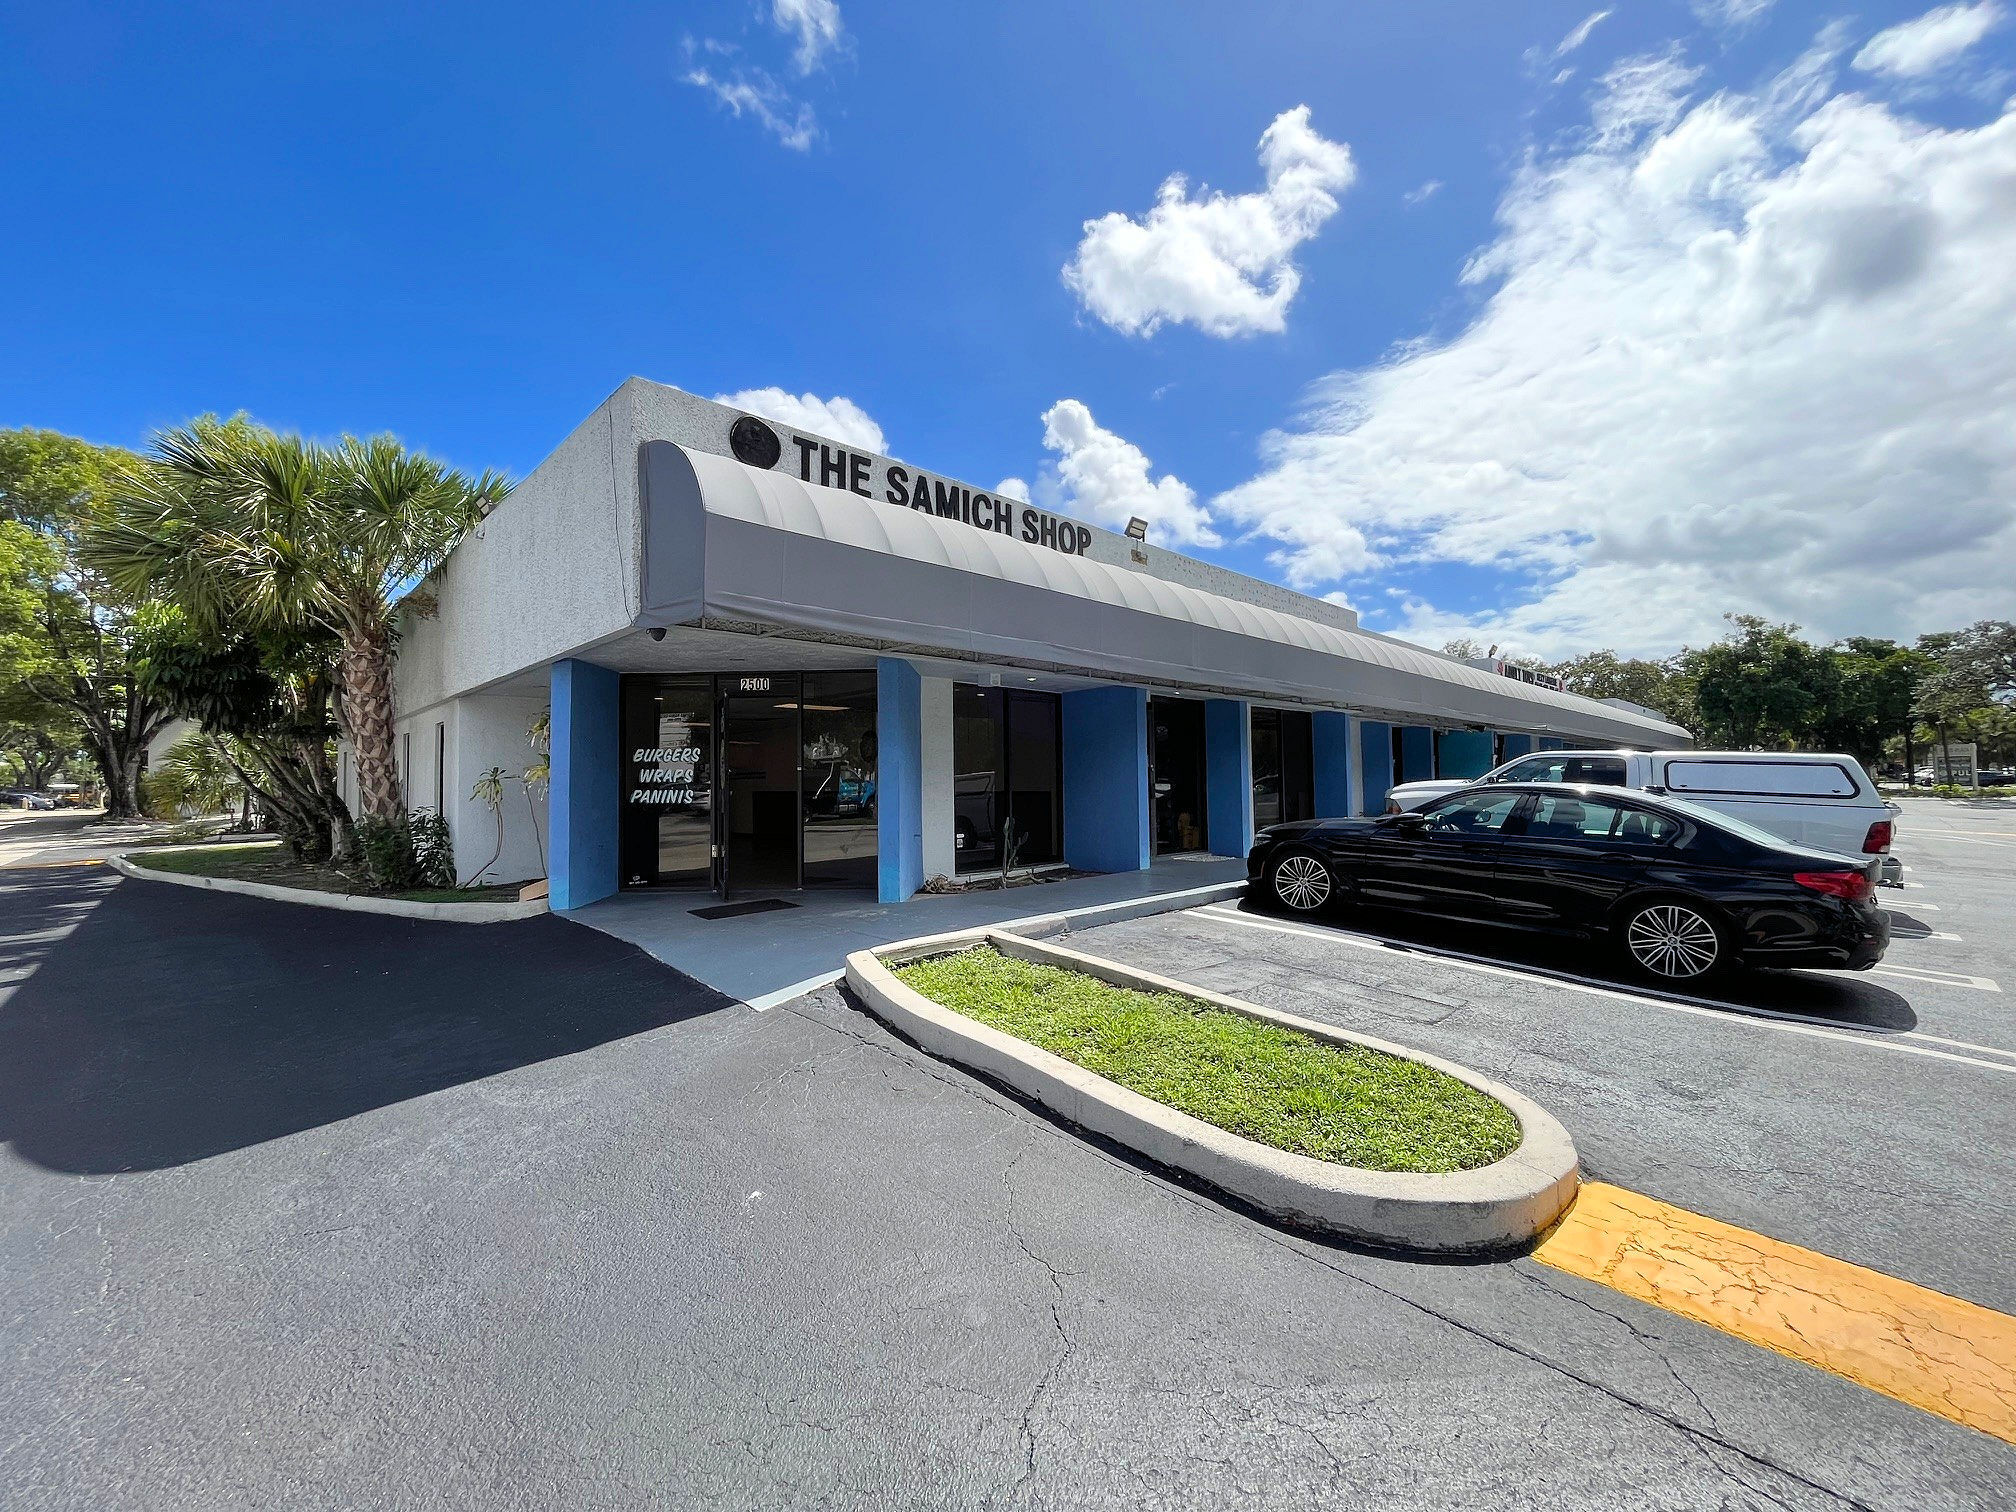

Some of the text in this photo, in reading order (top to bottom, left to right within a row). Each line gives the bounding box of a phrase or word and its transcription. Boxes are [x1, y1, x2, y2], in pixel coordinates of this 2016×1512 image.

[793, 435, 1092, 556] THE SAMICH SHOP
[741, 678, 769, 691] 2500
[633, 747, 700, 763] BURGERS
[639, 769, 694, 784] WRAPS
[630, 789, 694, 804] PANINIS
